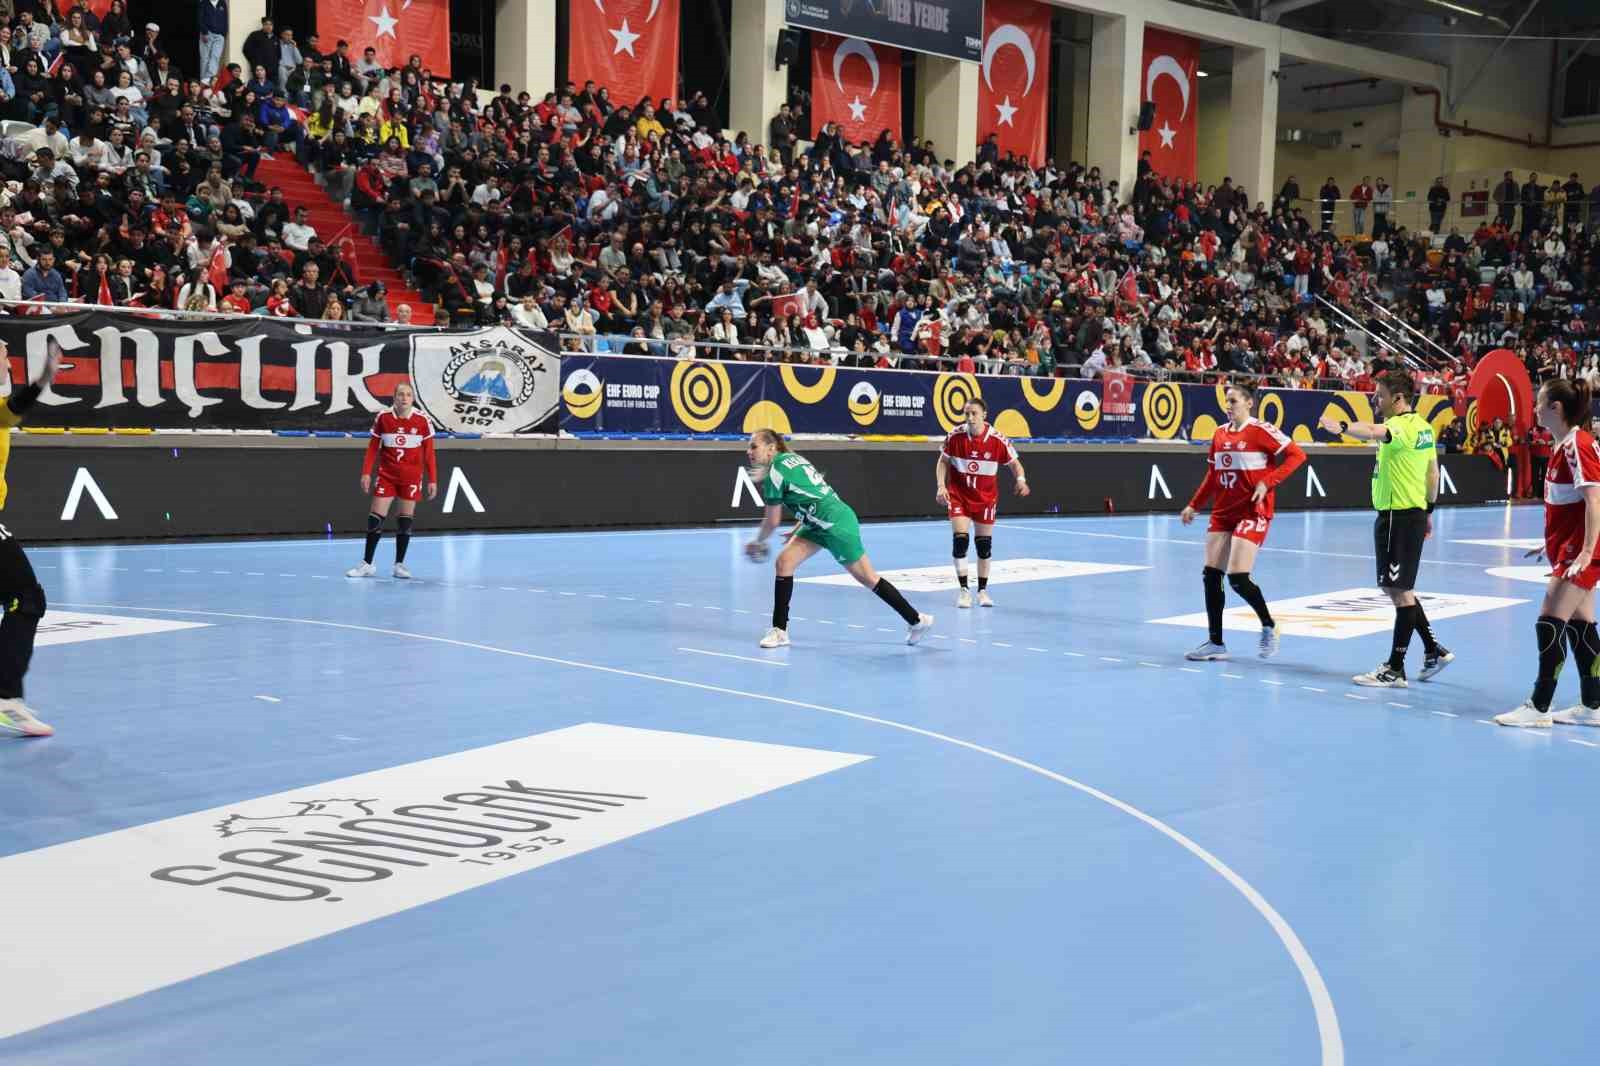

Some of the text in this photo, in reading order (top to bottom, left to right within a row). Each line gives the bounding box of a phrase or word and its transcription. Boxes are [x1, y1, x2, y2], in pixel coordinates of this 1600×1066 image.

[914, 2, 949, 32] YERDE
[449, 339, 546, 373] AKSARAY
[606, 384, 660, 399] EHF EURO CUP
[912, 396, 925, 409] CUP
[453, 403, 505, 420] SPOR
[460, 416, 493, 427] 1967
[396, 448, 404, 462] 7
[966, 475, 977, 489] 11
[1220, 471, 1237, 488] 47
[410, 484, 418, 498] 7
[983, 507, 994, 521] 11
[459, 835, 566, 866] 1953
